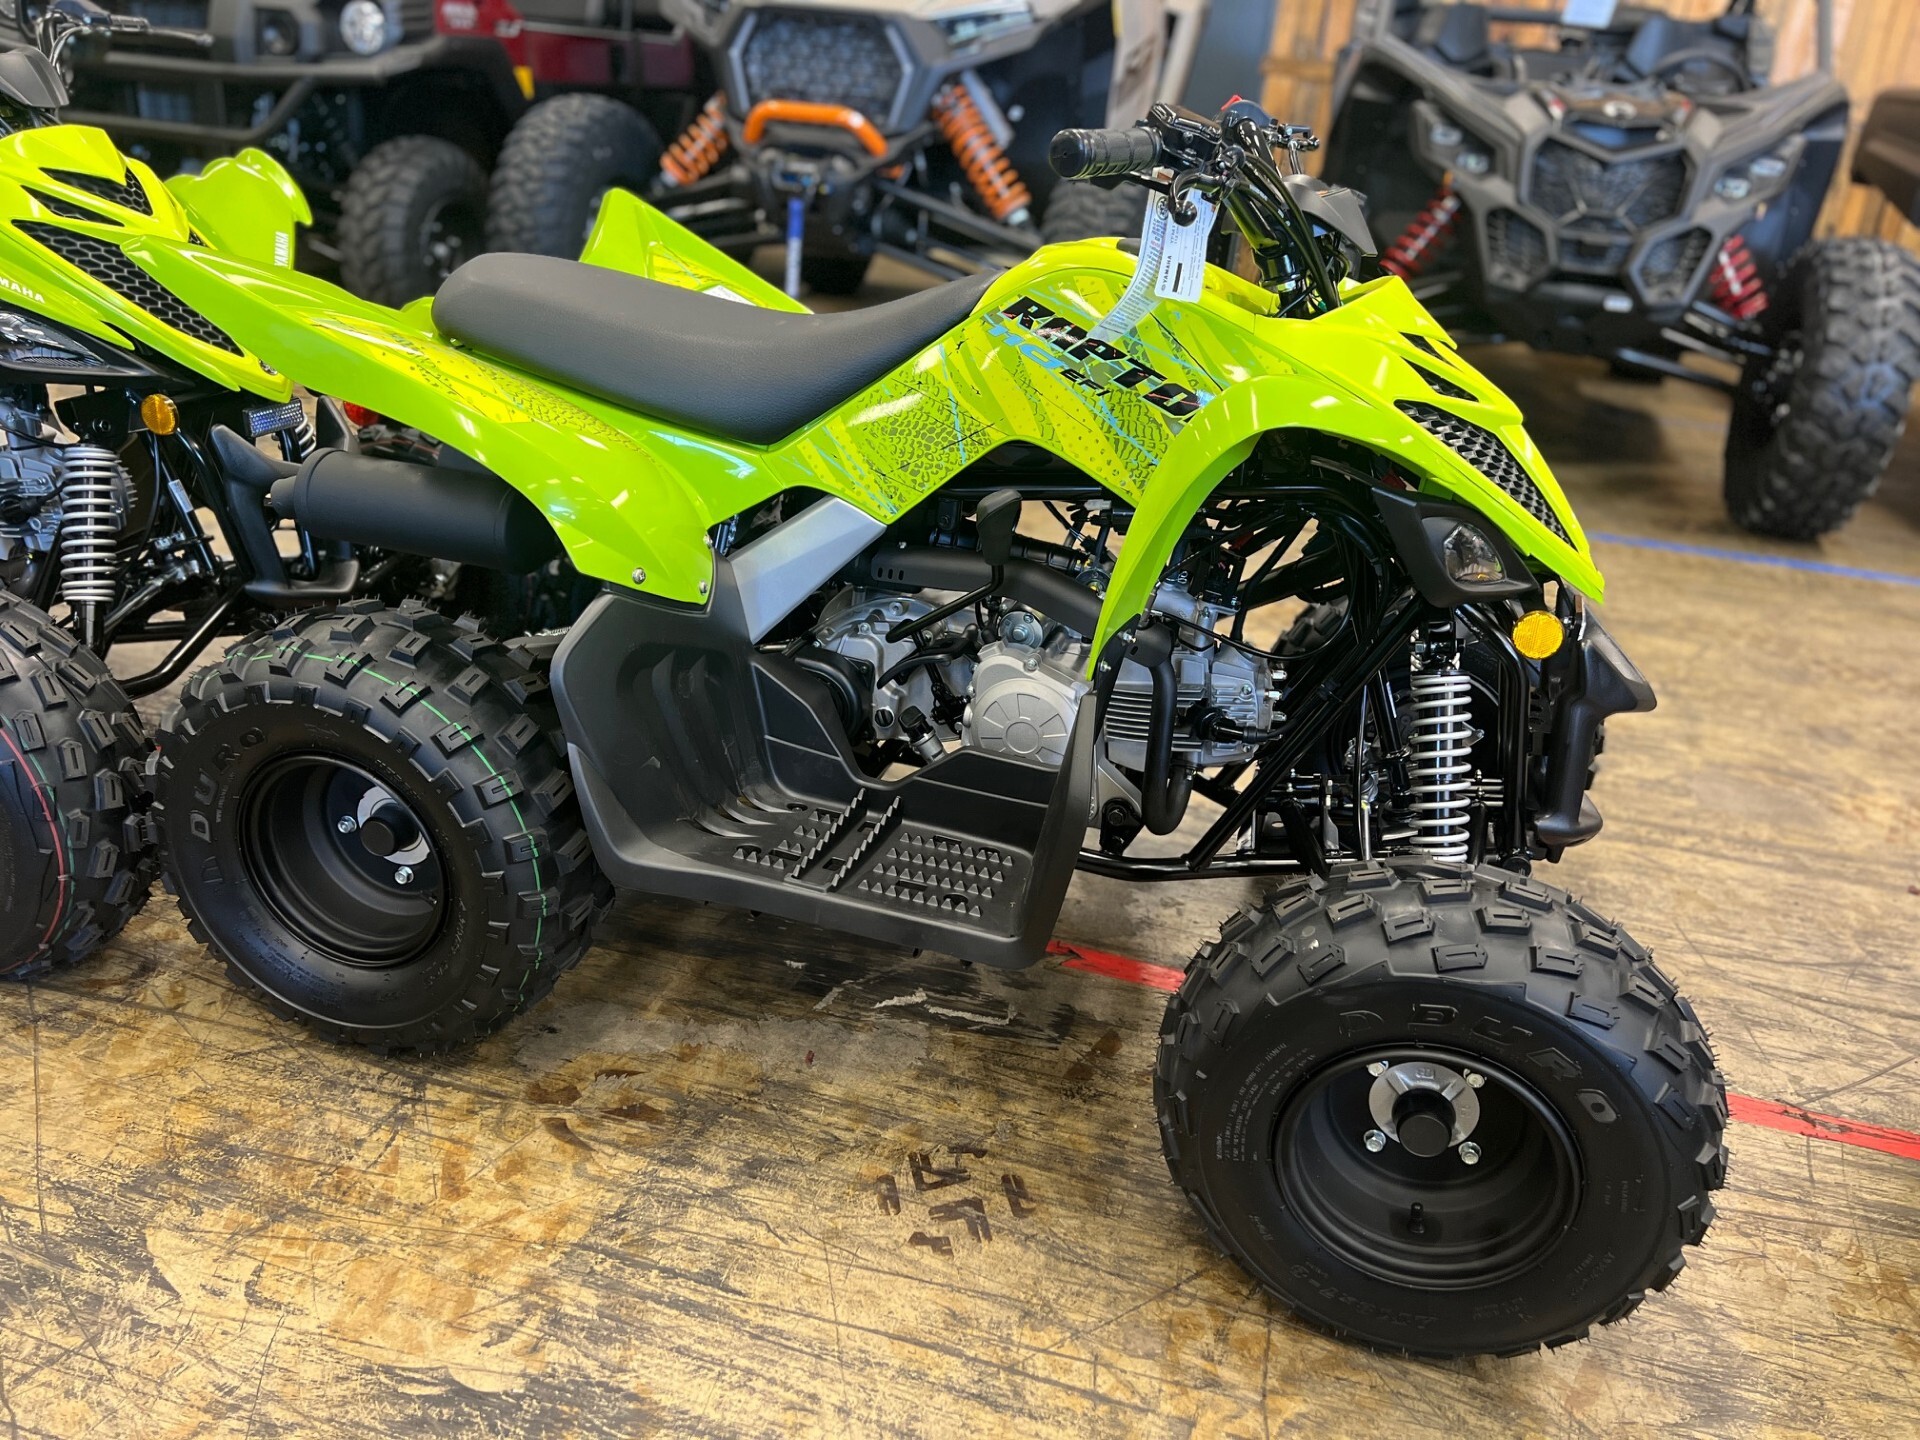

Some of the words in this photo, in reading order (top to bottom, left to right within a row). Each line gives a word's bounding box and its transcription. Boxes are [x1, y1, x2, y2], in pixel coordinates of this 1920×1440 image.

[274, 230, 289, 267] YAMAHA
[1163, 255, 1172, 283] YAMAHA
[1000, 296, 1213, 424] RAPTO
[1059, 368, 1111, 397] EFI
[189, 726, 267, 843] DURO
[1407, 1002, 1622, 1124] DURO
